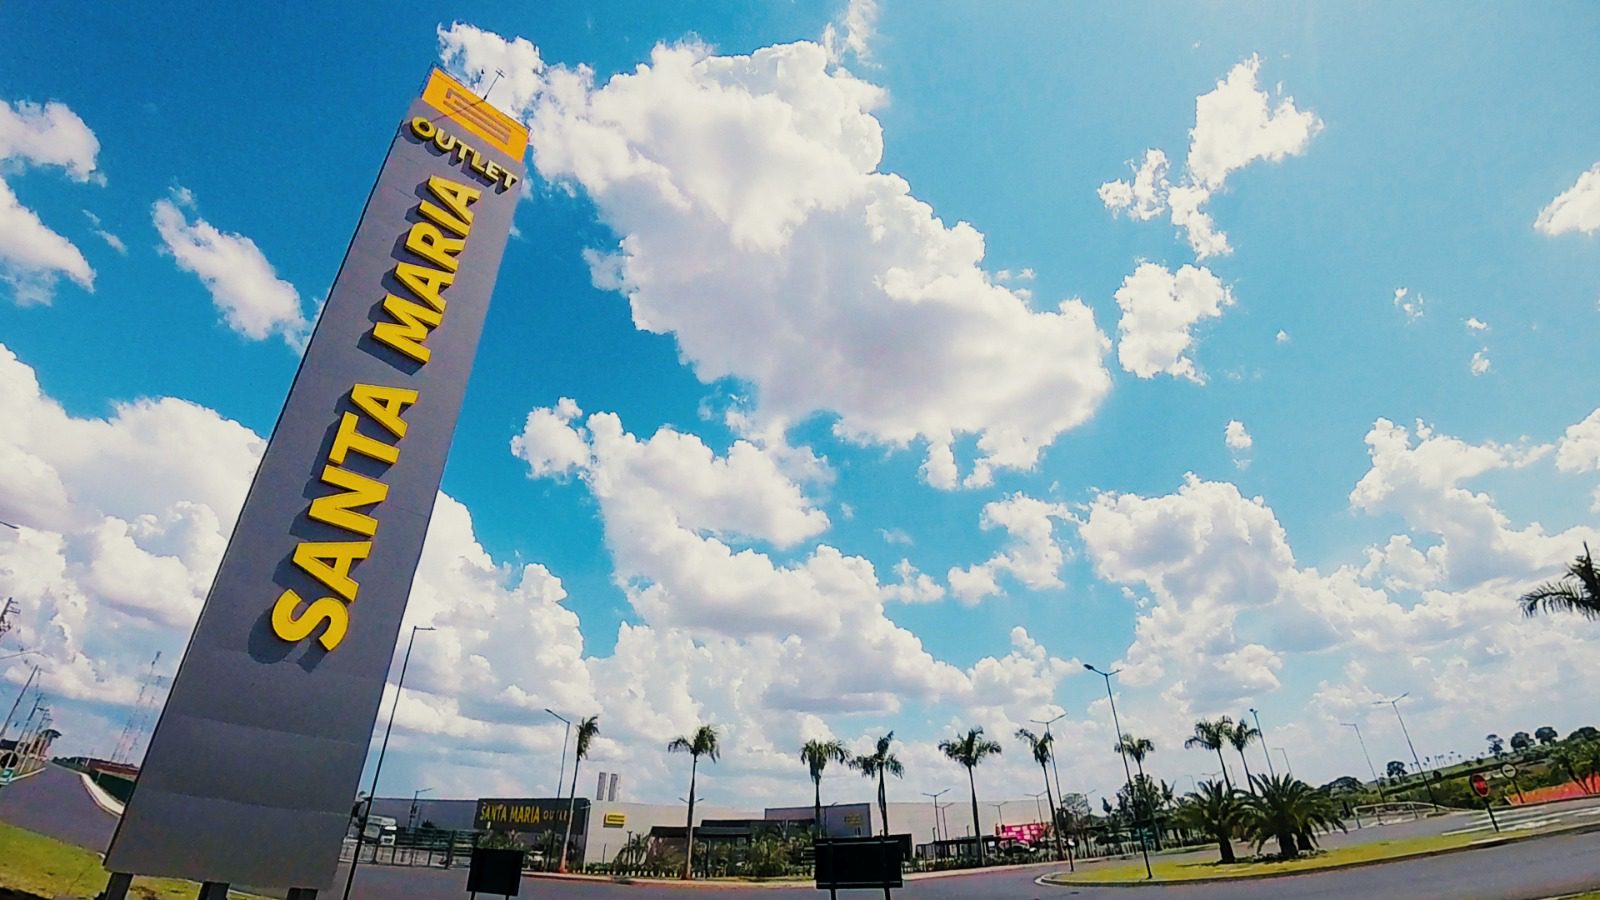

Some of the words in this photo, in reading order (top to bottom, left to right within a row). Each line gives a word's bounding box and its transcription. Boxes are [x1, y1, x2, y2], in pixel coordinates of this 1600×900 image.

[410, 116, 518, 189] OUTLET
[271, 382, 419, 652] SANTA
[371, 174, 482, 364] MARIA
[480, 804, 507, 821] SANTA
[509, 805, 540, 823] MARIA
